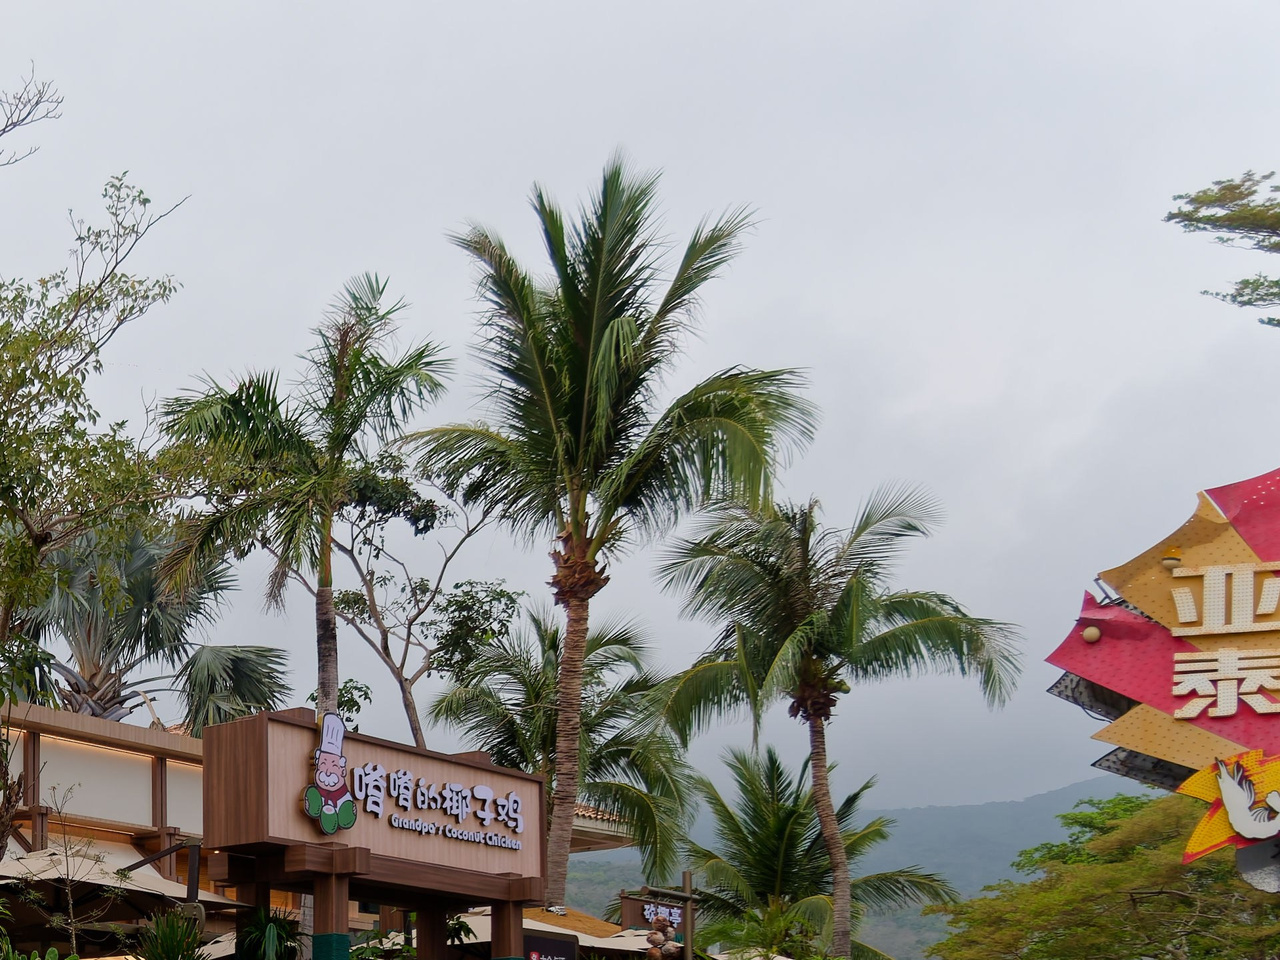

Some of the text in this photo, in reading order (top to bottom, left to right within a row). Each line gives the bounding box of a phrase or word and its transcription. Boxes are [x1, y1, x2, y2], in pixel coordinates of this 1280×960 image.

[391, 813, 522, 850] Grandpa's Coconut Chicken
